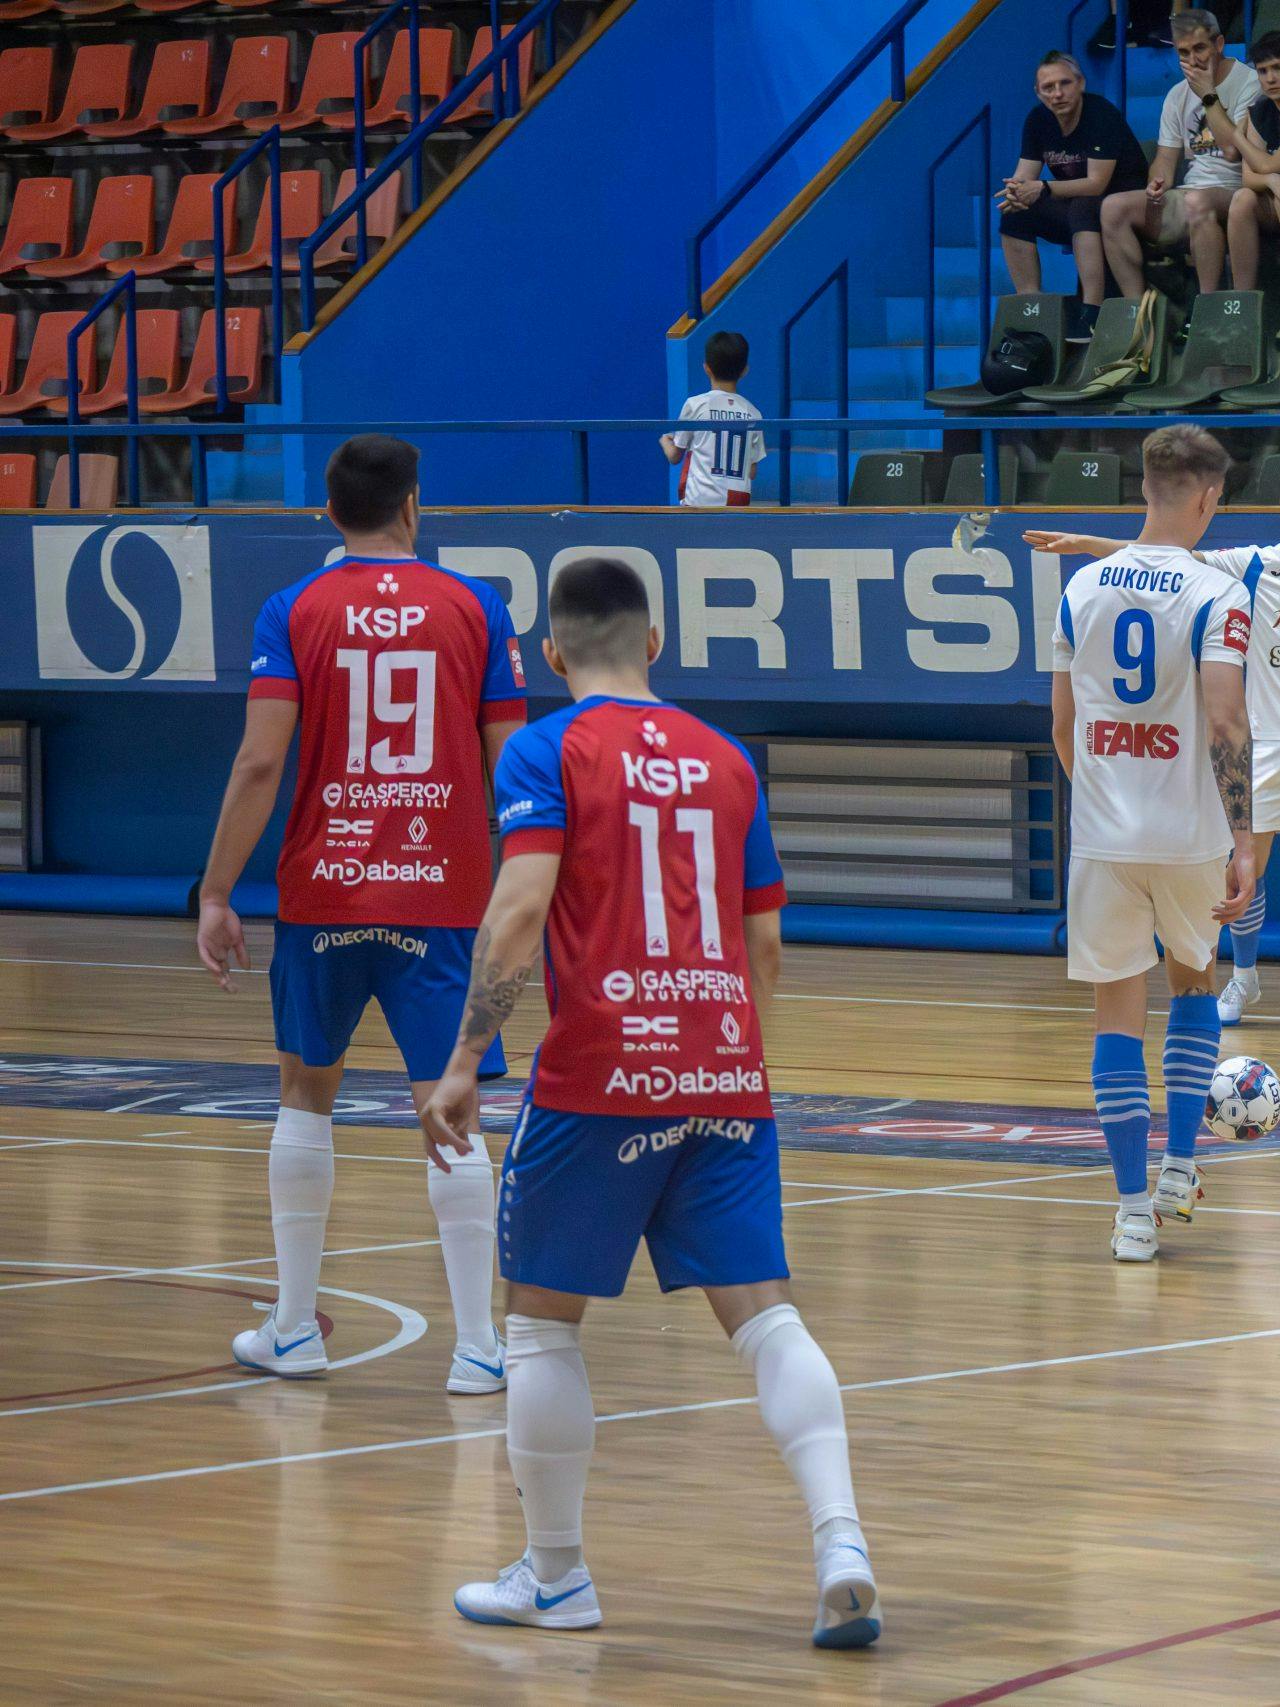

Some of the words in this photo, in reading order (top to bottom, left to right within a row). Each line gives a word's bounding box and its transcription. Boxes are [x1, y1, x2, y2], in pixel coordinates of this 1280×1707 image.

[1023, 303, 1041, 317] 34
[1224, 300, 1241, 315] 32
[711, 430, 744, 478] 10
[1081, 462, 1099, 477] 32
[886, 463, 904, 477] 28
[1099, 566, 1184, 593] BUKOVEC
[345, 605, 426, 638] KSP
[1113, 608, 1156, 705] 9
[336, 648, 437, 775] 19
[1094, 719, 1180, 760] FAKS
[621, 751, 710, 797] KSP
[348, 782, 452, 800] GASPEROV
[349, 799, 448, 808] AUTOMOBILI
[628, 801, 723, 961] 11
[331, 928, 428, 959] DECATHLON
